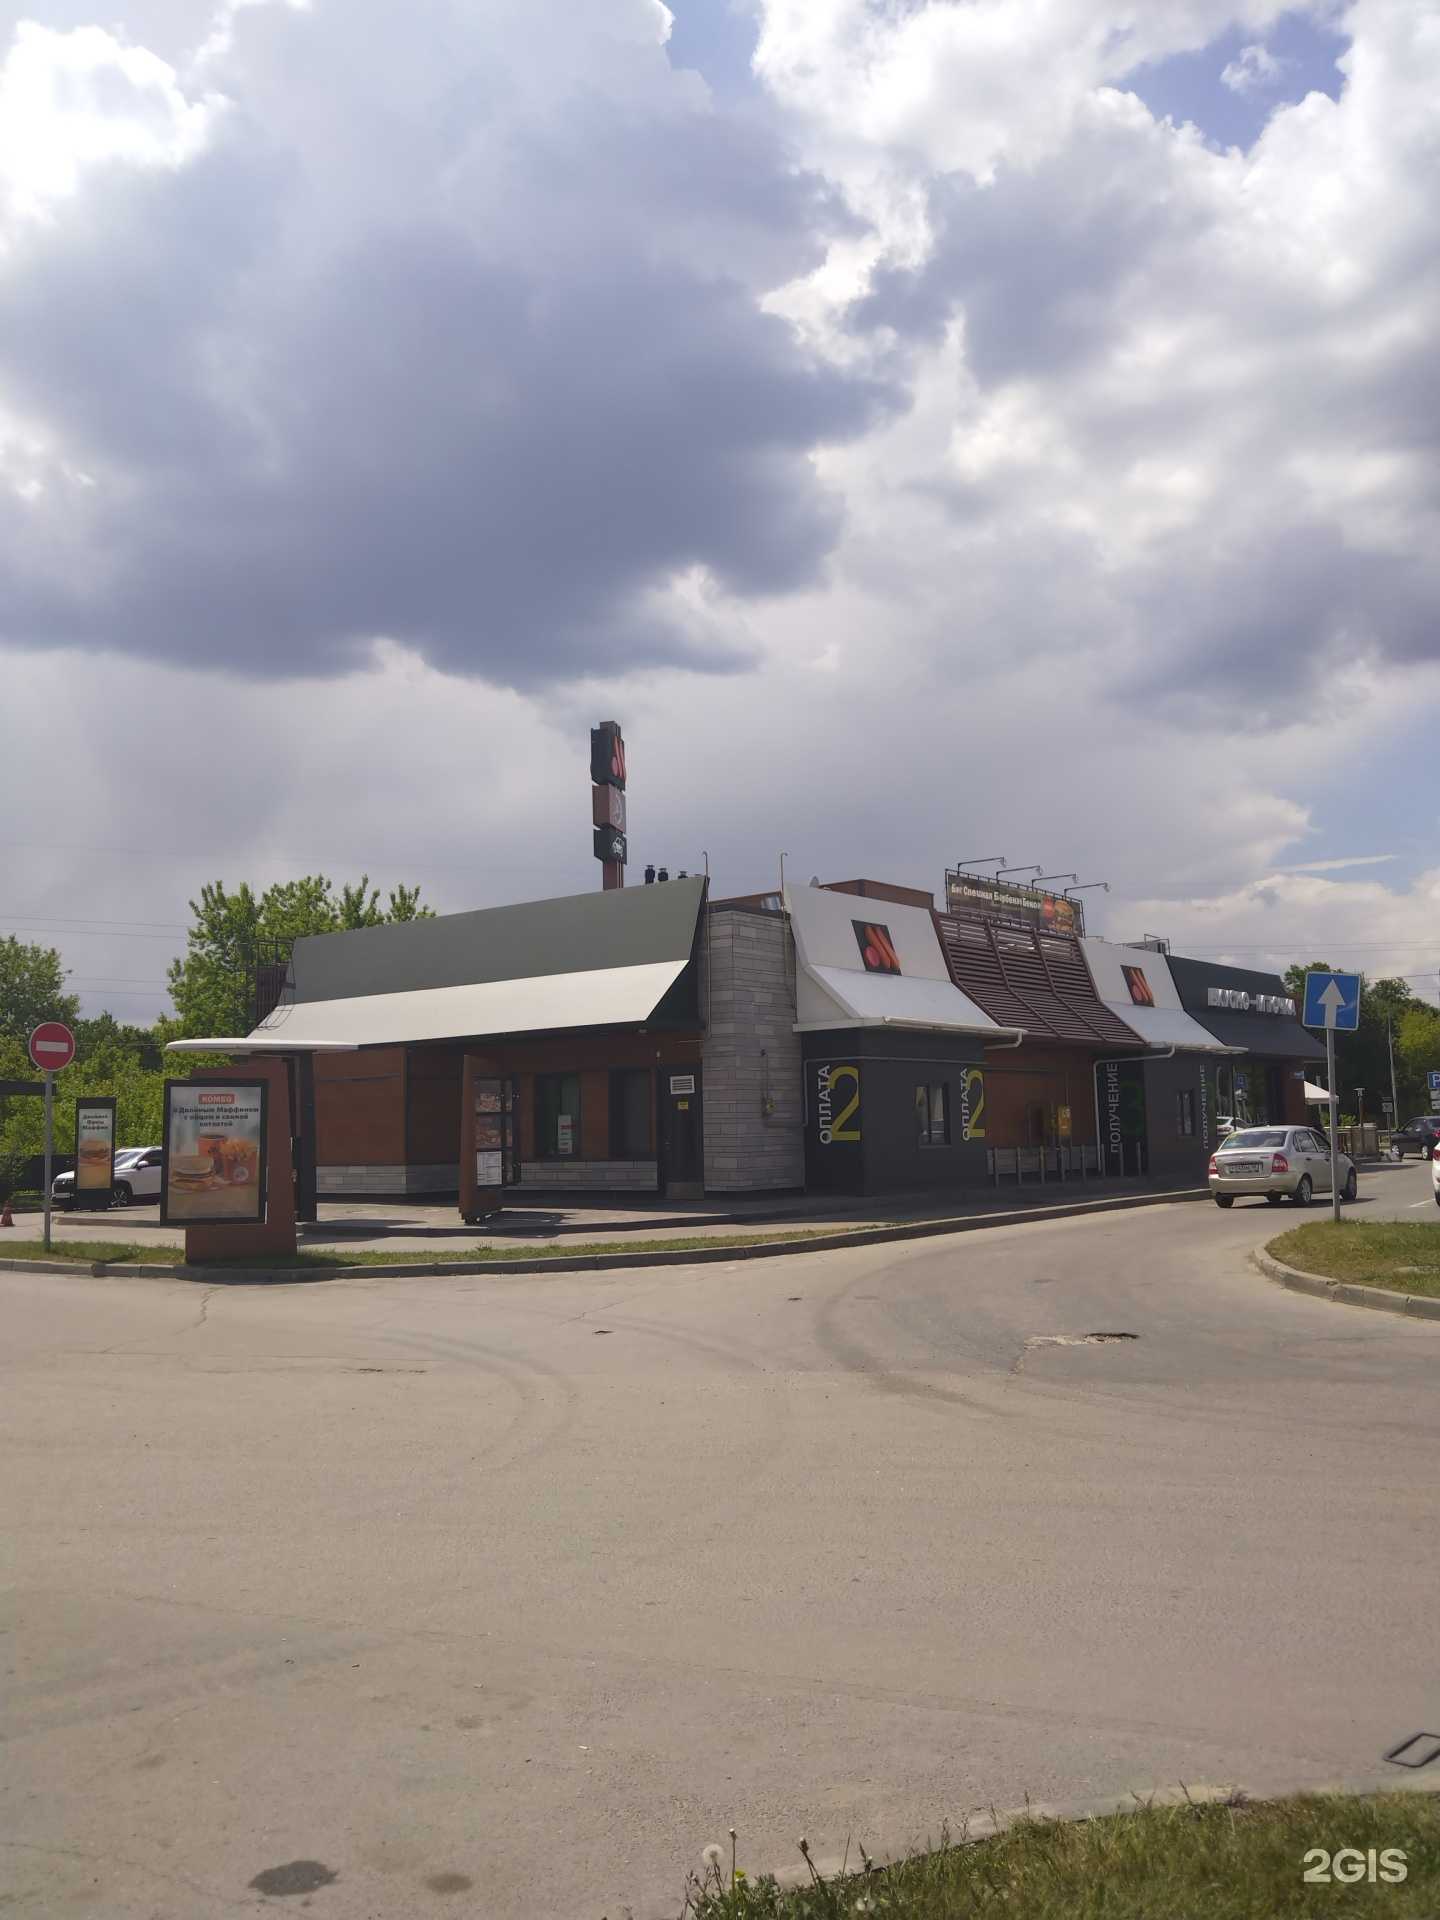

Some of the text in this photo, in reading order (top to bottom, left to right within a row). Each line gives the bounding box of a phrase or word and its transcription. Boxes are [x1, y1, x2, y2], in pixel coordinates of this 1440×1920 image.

[818, 1064, 832, 1144] ОПЛАТА
[829, 1066, 860, 1141] 2
[960, 1068, 970, 1141] ОПЛАТА
[967, 1070, 985, 1137] 2
[1106, 1063, 1120, 1152] ПОЛУЧЕНИЕ
